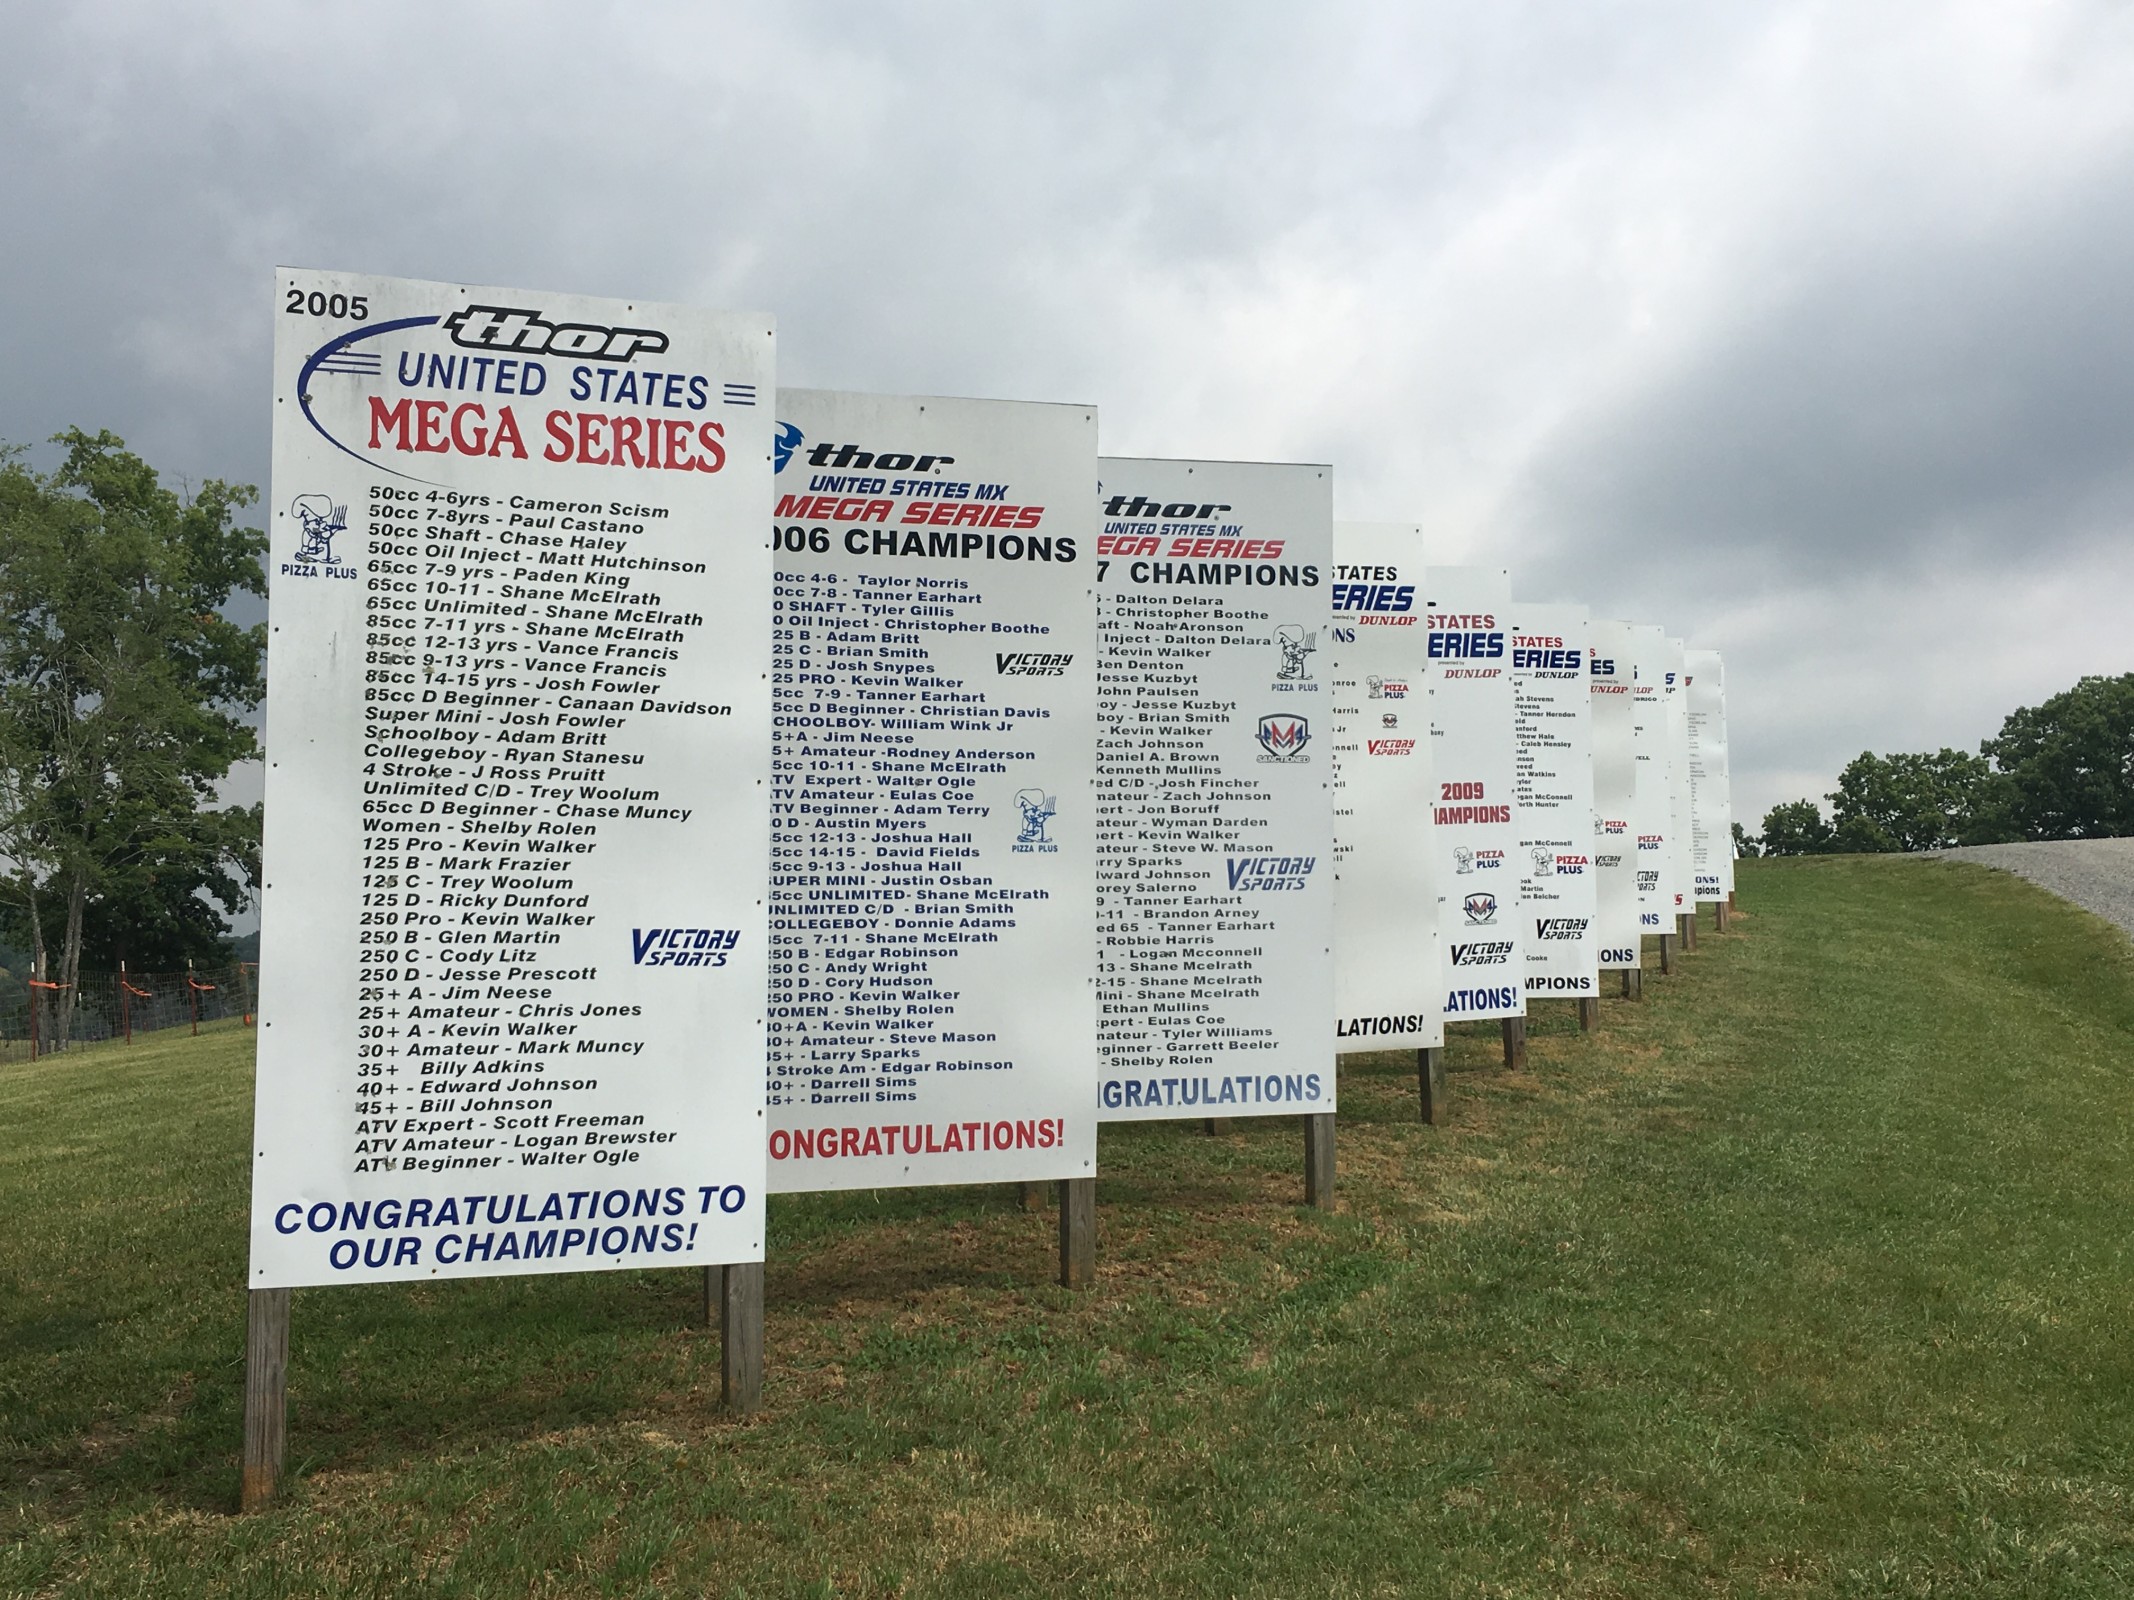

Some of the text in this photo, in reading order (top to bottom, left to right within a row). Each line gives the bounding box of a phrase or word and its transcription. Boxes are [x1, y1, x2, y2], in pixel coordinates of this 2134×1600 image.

[286, 288, 368, 320] 2005
[443, 304, 669, 362] thor
[398, 351, 709, 410] UNITED STATES
[368, 396, 726, 474] MEGA SERIES
[806, 443, 955, 472] thor
[809, 475, 1009, 501] UNITED STATES MX
[369, 485, 669, 519] 50cc 4-6yrs Cameron Scism
[1102, 495, 1231, 519] thor
[774, 495, 1045, 529] MEGA SERIES
[1104, 522, 1243, 537] UNITED STATES MX
[773, 526, 1077, 563] 06 CHAMPIONS
[1166, 538, 1285, 559] SERIES
[367, 540, 707, 574] 50cc Oil Inject Matt Hutchinson
[281, 564, 357, 580] PIZZA PLUS
[773, 571, 969, 590] 0cc 4-6 Taylor Norris
[1130, 562, 1319, 587] CHAMPIONS
[772, 614, 1050, 635] 0 Oil Inject Christopher Boothe
[1359, 615, 1418, 626] DUNLOP
[1332, 627, 1355, 643] NS
[1428, 632, 1504, 658] ERIES
[996, 653, 1073, 675] VICTORY
[1513, 649, 1581, 669] ERIES
[1590, 660, 1615, 675] ES
[772, 672, 964, 688] 25 PRO Kevin Walker
[1006, 666, 1064, 676] SPORTS
[1143, 673, 1198, 686] Kuzbyt
[1444, 669, 1501, 679] DUNLOP
[1534, 671, 1579, 679] DUNLOP
[1271, 684, 1318, 692] PIZZA PLUS
[1384, 684, 1409, 692] PIZZA
[880, 718, 945, 730] William
[949, 719, 992, 731] Wink
[996, 721, 1014, 732] Jr
[1138, 712, 1180, 723] Brian
[1184, 713, 1230, 723] Smith
[363, 743, 645, 765] Collegeboy Ryan Stanesu
[1367, 740, 1416, 755] VICTORY
[1441, 782, 1484, 800] 2009
[362, 817, 597, 838] Women Shelby Rolen
[1151, 817, 1208, 830] Wyman
[1212, 817, 1268, 827] Darden
[1012, 844, 1058, 853] PIZZA PLUS
[1476, 850, 1504, 860] PIZZA
[1476, 860, 1500, 868] PLUS
[1556, 856, 1588, 865] PIZZA
[1595, 856, 1621, 866] VICTORY
[1226, 857, 1316, 891] VICTORY
[1557, 866, 1583, 875] PLUS
[826, 875, 866, 886] MINI
[880, 874, 934, 886] Justin
[939, 875, 993, 886] Osban
[1238, 877, 1306, 891] SPORTS
[359, 911, 596, 926] 250 Pro Kevin Walker
[1119, 922, 1139, 933] 65
[1157, 922, 1213, 932] Tanner
[1216, 920, 1275, 931] Earhart
[1536, 919, 1588, 939] VICTORY
[1543, 931, 1582, 940] SPORTS
[631, 928, 740, 966] VICTORY
[1450, 941, 1514, 966] VICTORY
[645, 952, 727, 967] SPORTS
[1459, 955, 1507, 966] SPORTS
[1443, 986, 1517, 1012] ATIONS!
[357, 1039, 645, 1058] 30+ Amateur Mark Muncy
[1110, 1054, 1213, 1068] Shelby Rolen
[1098, 1074, 1321, 1108] GRATULATIONS
[769, 1119, 1064, 1160] ONGRATULATIONS!
[274, 1184, 746, 1235] CONGRATULATIONS TO
[329, 1222, 698, 1270] OUR CHAMPIONS!
